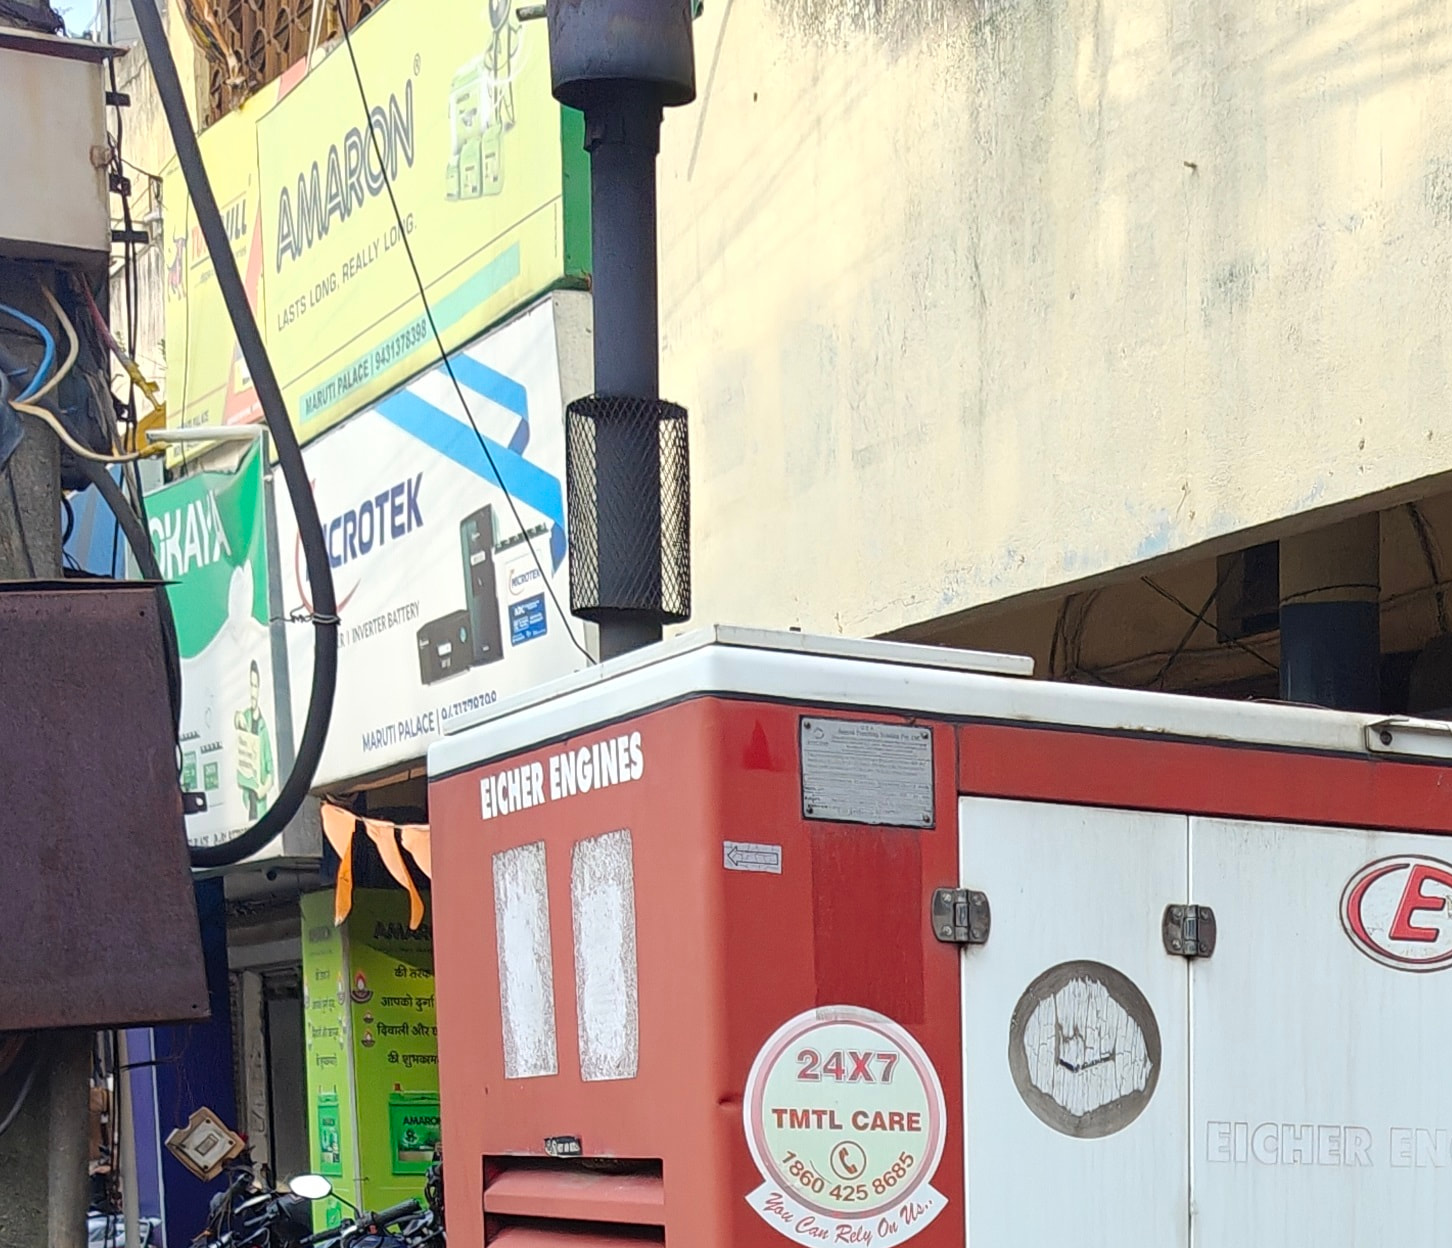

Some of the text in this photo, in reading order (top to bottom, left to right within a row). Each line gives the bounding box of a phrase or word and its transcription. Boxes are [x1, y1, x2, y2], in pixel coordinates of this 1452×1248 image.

[276, 79, 415, 275] AMARON
[277, 295, 307, 332] LASTS
[342, 237, 380, 284] REALLY
[305, 382, 336, 416] MARUTI
[337, 359, 369, 396] PALACE
[322, 471, 424, 570] CROTEK
[387, 600, 421, 630] BATTERY
[362, 723, 397, 753] MARUTI
[397, 711, 435, 742] PALACE
[480, 731, 644, 820] EICHER ENGINES
[796, 1049, 900, 1083] 24X7
[772, 1109, 922, 1132] TMTL CARE
[1206, 1121, 1374, 1168] EICHER
[782, 1151, 914, 1202] 1860 425 8685
[764, 1192, 794, 1222] You
[795, 1216, 829, 1240] Can
[834, 1224, 873, 1247] Rely
[877, 1217, 898, 1238] On
